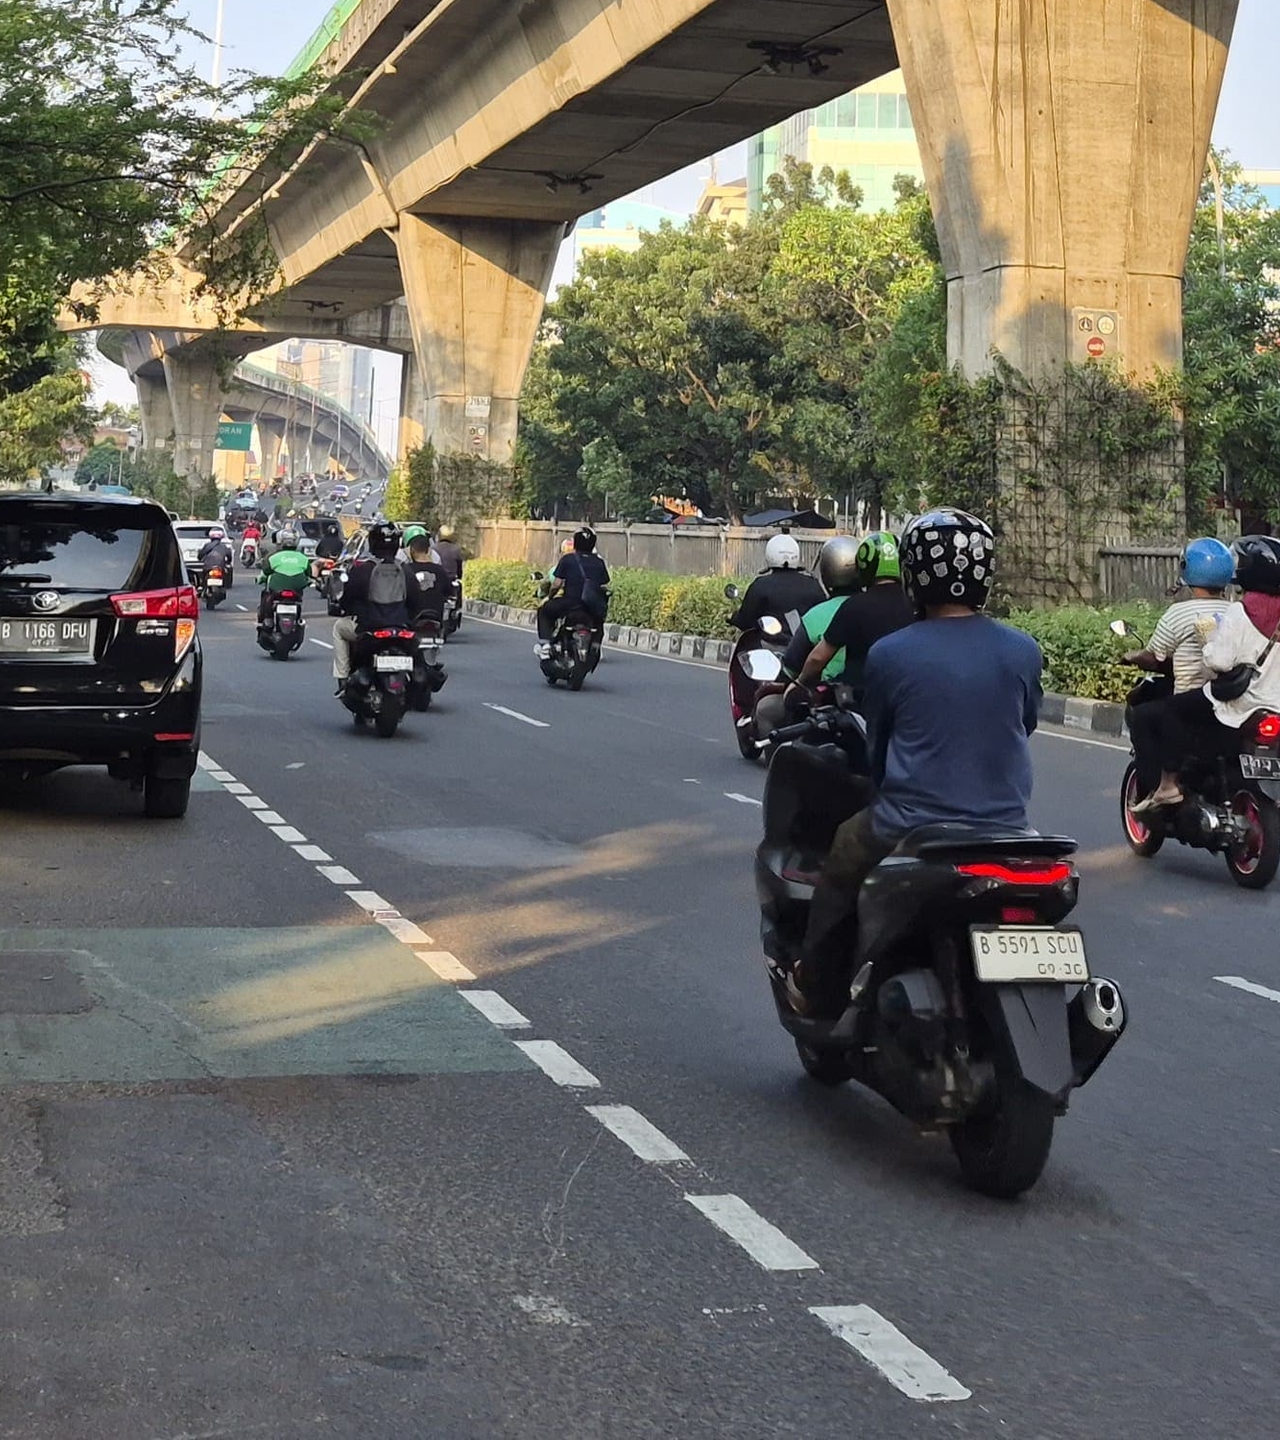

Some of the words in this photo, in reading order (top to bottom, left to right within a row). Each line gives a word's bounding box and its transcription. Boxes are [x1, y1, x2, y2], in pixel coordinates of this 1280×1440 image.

[2, 624, 10, 638] B
[24, 623, 56, 639] 1166
[62, 623, 87, 639] DFU
[980, 936, 990, 954] B
[999, 936, 1040, 954] 5591
[1048, 937, 1078, 953] SCU
